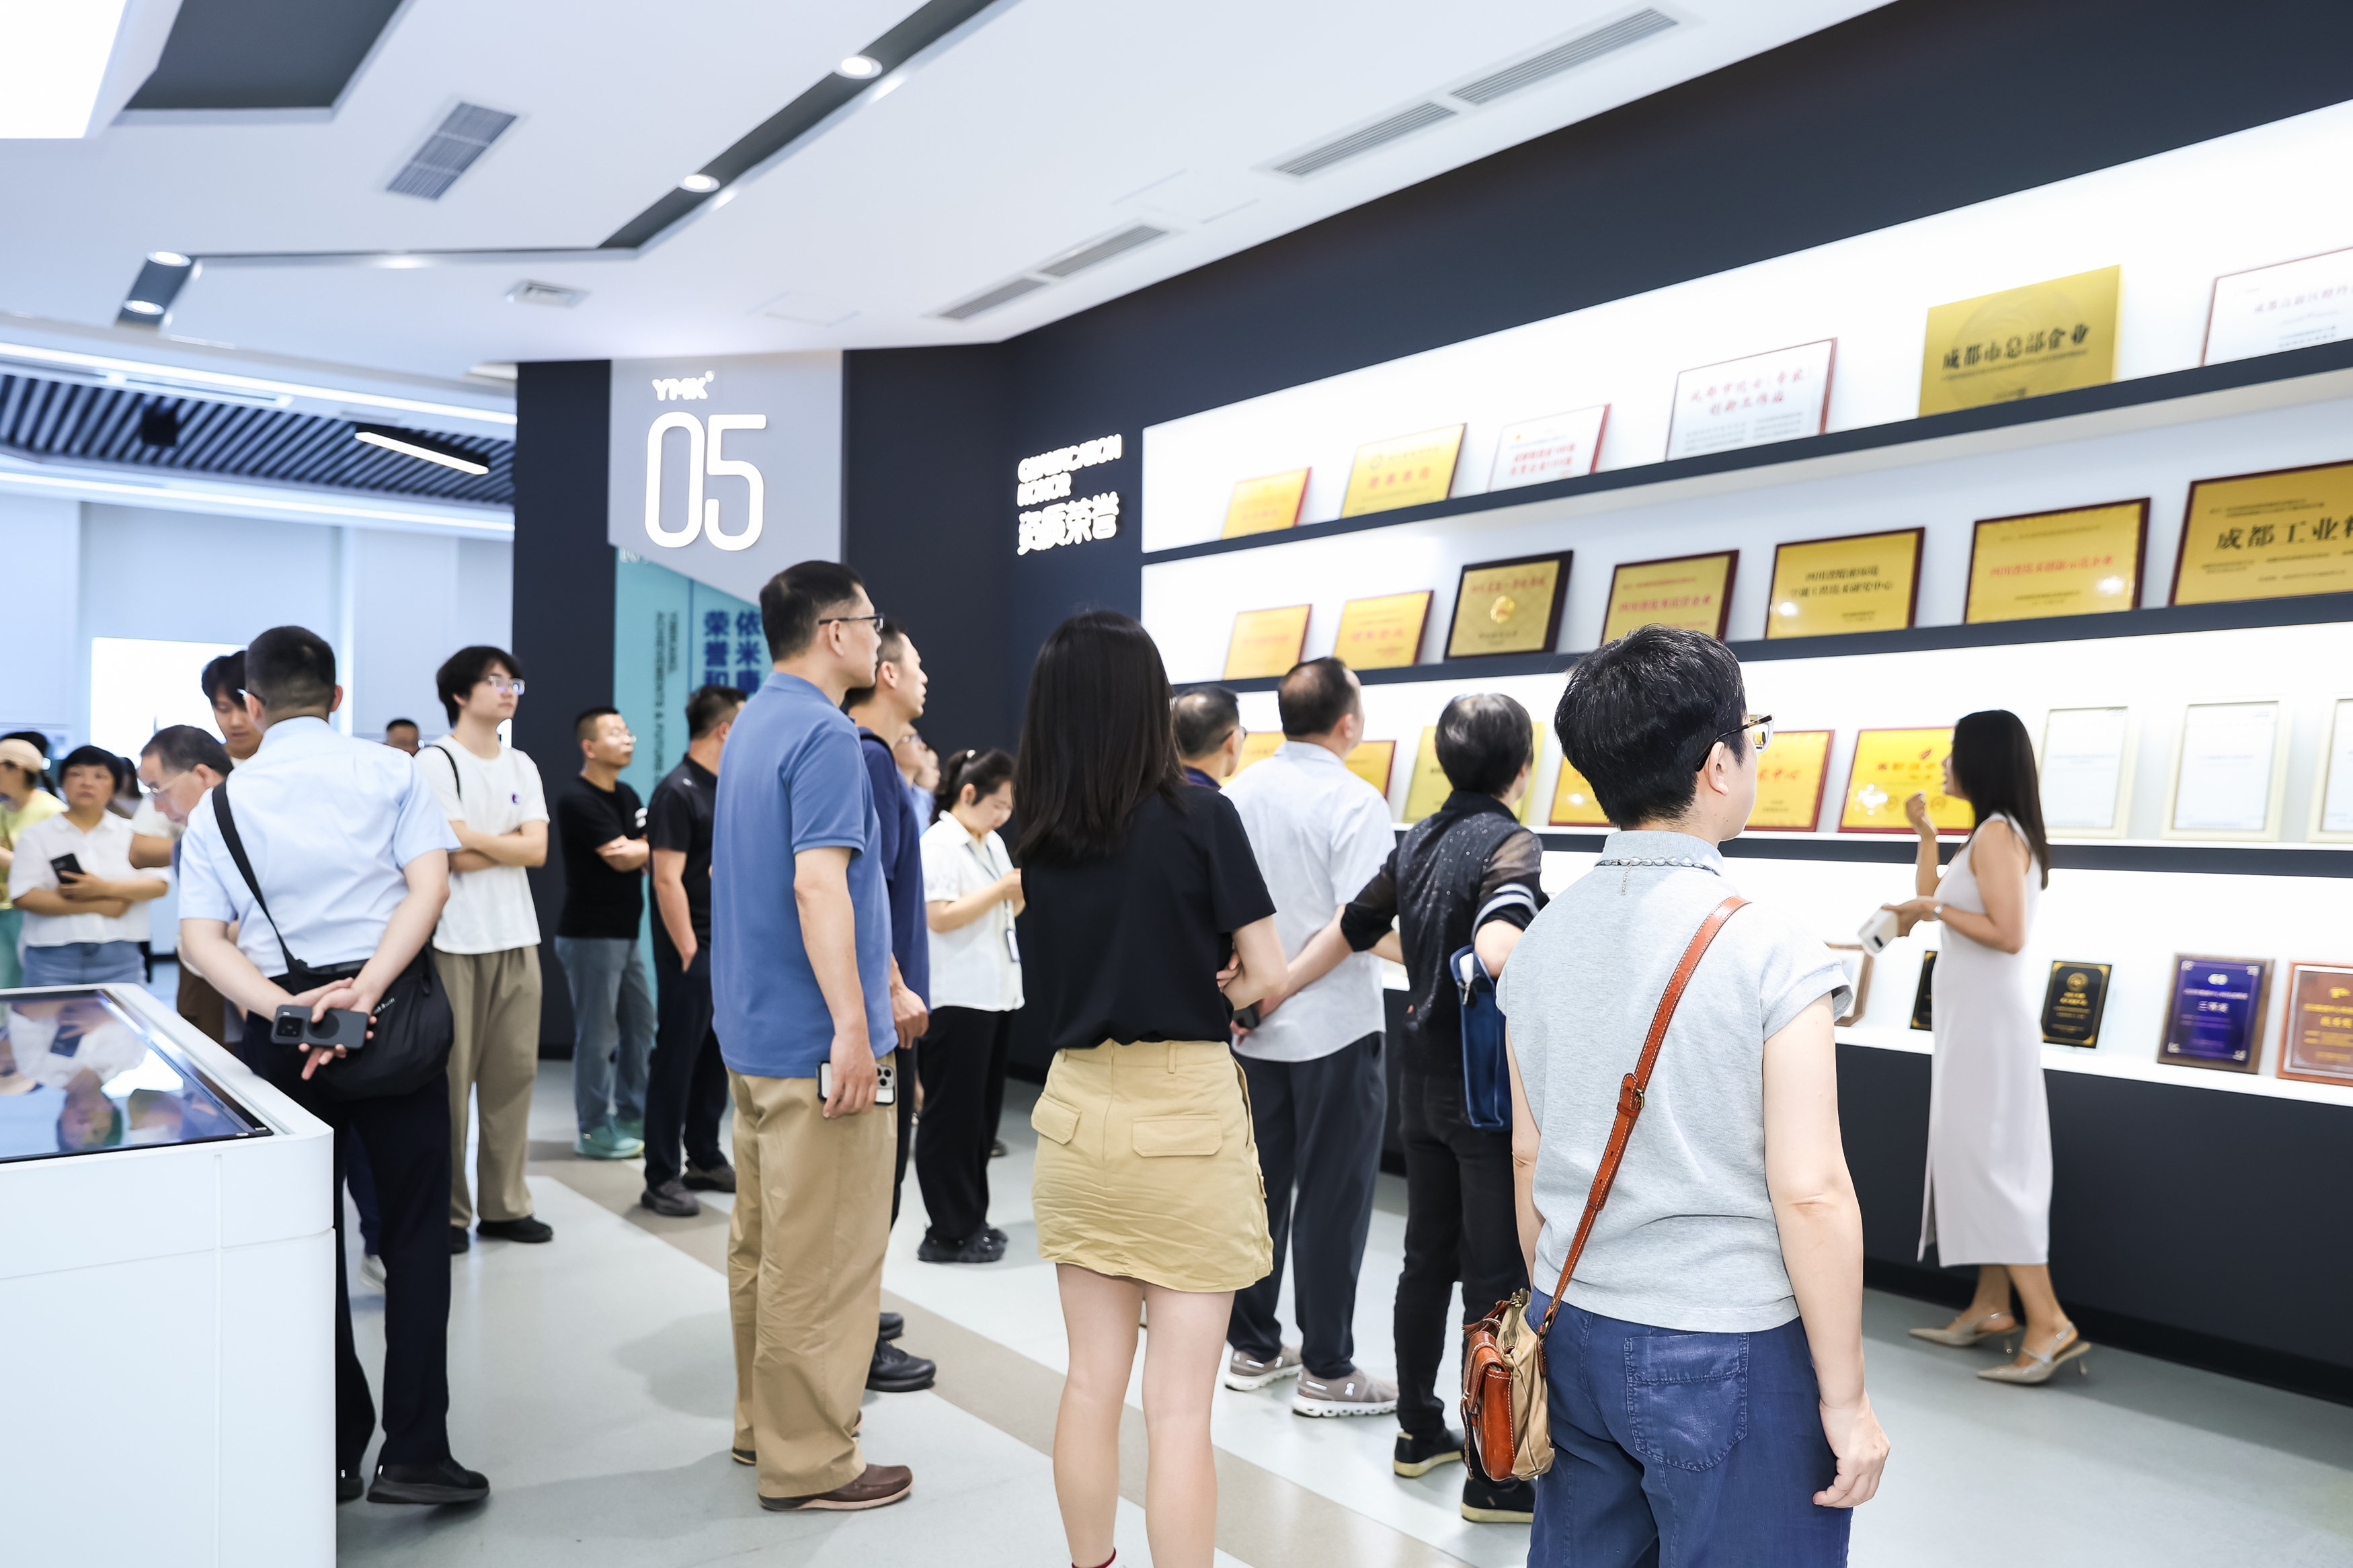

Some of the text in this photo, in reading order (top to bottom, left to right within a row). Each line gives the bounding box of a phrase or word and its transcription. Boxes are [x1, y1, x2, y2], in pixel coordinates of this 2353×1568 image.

[1943, 323, 2089, 370] 成都市总部企业
[644, 411, 768, 551] 05
[1017, 491, 1120, 556] 资质荣誉
